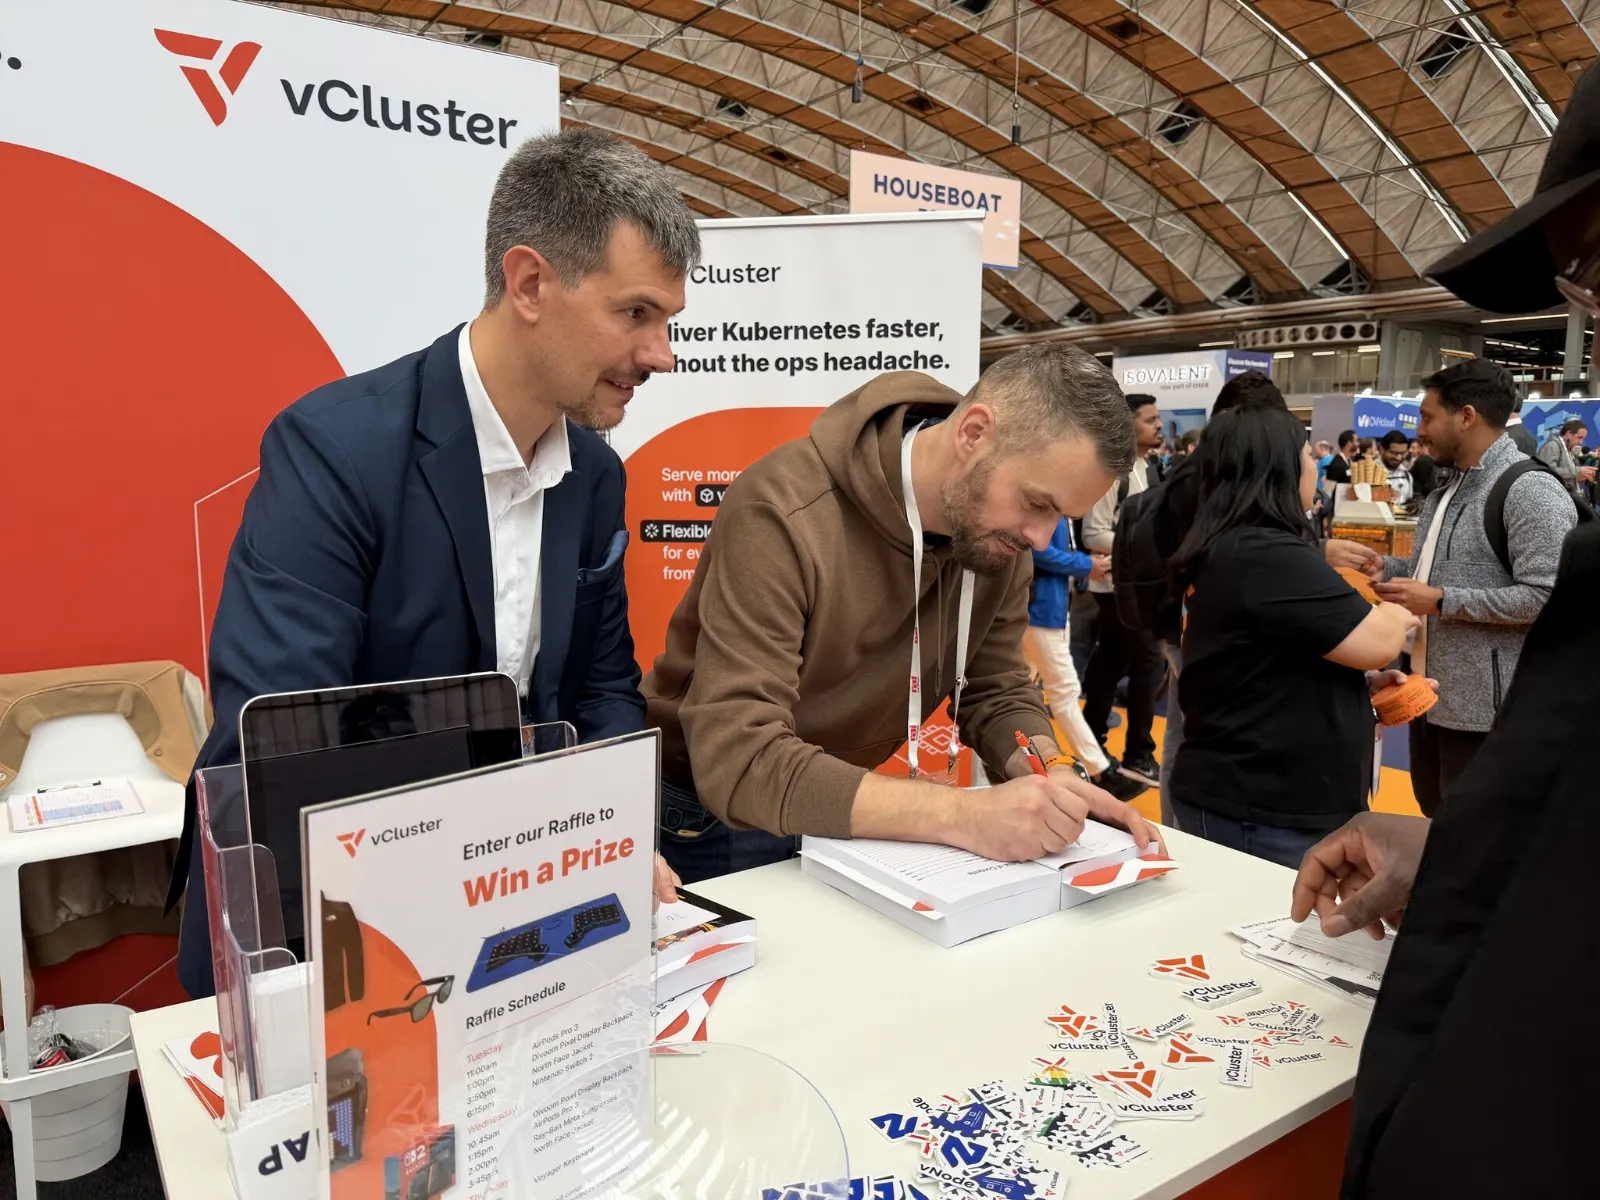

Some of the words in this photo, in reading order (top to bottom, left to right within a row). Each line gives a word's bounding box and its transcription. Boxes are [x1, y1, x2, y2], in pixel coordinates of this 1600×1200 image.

[280, 79, 517, 148] vCluster
[874, 173, 1002, 212] HOUSEBOAT
[690, 264, 781, 284] Cluster
[668, 322, 717, 342] liver
[722, 321, 861, 341] Kubernetes
[866, 318, 943, 341] faster,
[673, 354, 726, 373] hout
[731, 353, 769, 373] the
[774, 356, 818, 376] ops
[824, 350, 950, 371] headache.
[1122, 365, 1211, 384] ISOVALENT
[661, 467, 703, 481] Serve
[662, 488, 692, 501] with
[663, 546, 682, 559] for
[371, 819, 443, 846] vCluster
[463, 836, 511, 860] Enter
[516, 826, 544, 846] our
[548, 812, 595, 836] Raffle
[599, 807, 614, 821] to
[463, 867, 529, 907] Win
[536, 861, 554, 885] a
[561, 837, 634, 877] Prize
[1182, 979, 1258, 997] vCluster
[466, 1005, 505, 1029] Raffle
[508, 980, 566, 1012] Schedule
[1152, 1013, 1187, 1034] vCluster
[1249, 1021, 1302, 1033] vCluster
[532, 1034, 559, 1050] AirPods
[561, 1027, 573, 1038] Pro
[574, 1023, 579, 1031] 3
[532, 1045, 559, 1062] Divoom
[559, 1037, 577, 1050] Pixel
[577, 1026, 601, 1042] Display
[602, 1011, 634, 1030] Backpack
[1049, 1042, 1109, 1051] vCluster
[1197, 1036, 1250, 1045] vCluster
[467, 1043, 503, 1063] Tuesday
[532, 1061, 552, 1075] North
[553, 1052, 571, 1064] Face
[571, 1041, 594, 1059] Jacket
[1226, 1046, 1243, 1082] vCluster
[1275, 1052, 1322, 1064] vCluster
[467, 1075, 495, 1091] 1:00pm
[532, 1068, 564, 1088] Nintendo
[565, 1056, 588, 1072] Switch
[533, 1101, 559, 1118] Divoom
[561, 1091, 577, 1105] Pixel
[577, 1080, 601, 1097] Display
[602, 1064, 633, 1083] Backpack
[533, 1110, 560, 1130] AirPods
[561, 1105, 574, 1116] Pro
[1117, 1103, 1194, 1113] vCluster
[468, 1106, 517, 1135] Wednesday
[533, 1123, 562, 1142] Ray-Ban
[563, 1114, 580, 1127] Meta
[258, 1130, 310, 1176] AP
[468, 1145, 494, 1162] 1:15pm
[533, 1139, 553, 1155] North
[554, 1131, 571, 1144] Face
[468, 1156, 498, 1176] 2:00pm
[533, 1165, 562, 1184] Voyager
[920, 1163, 975, 1189] vNode
